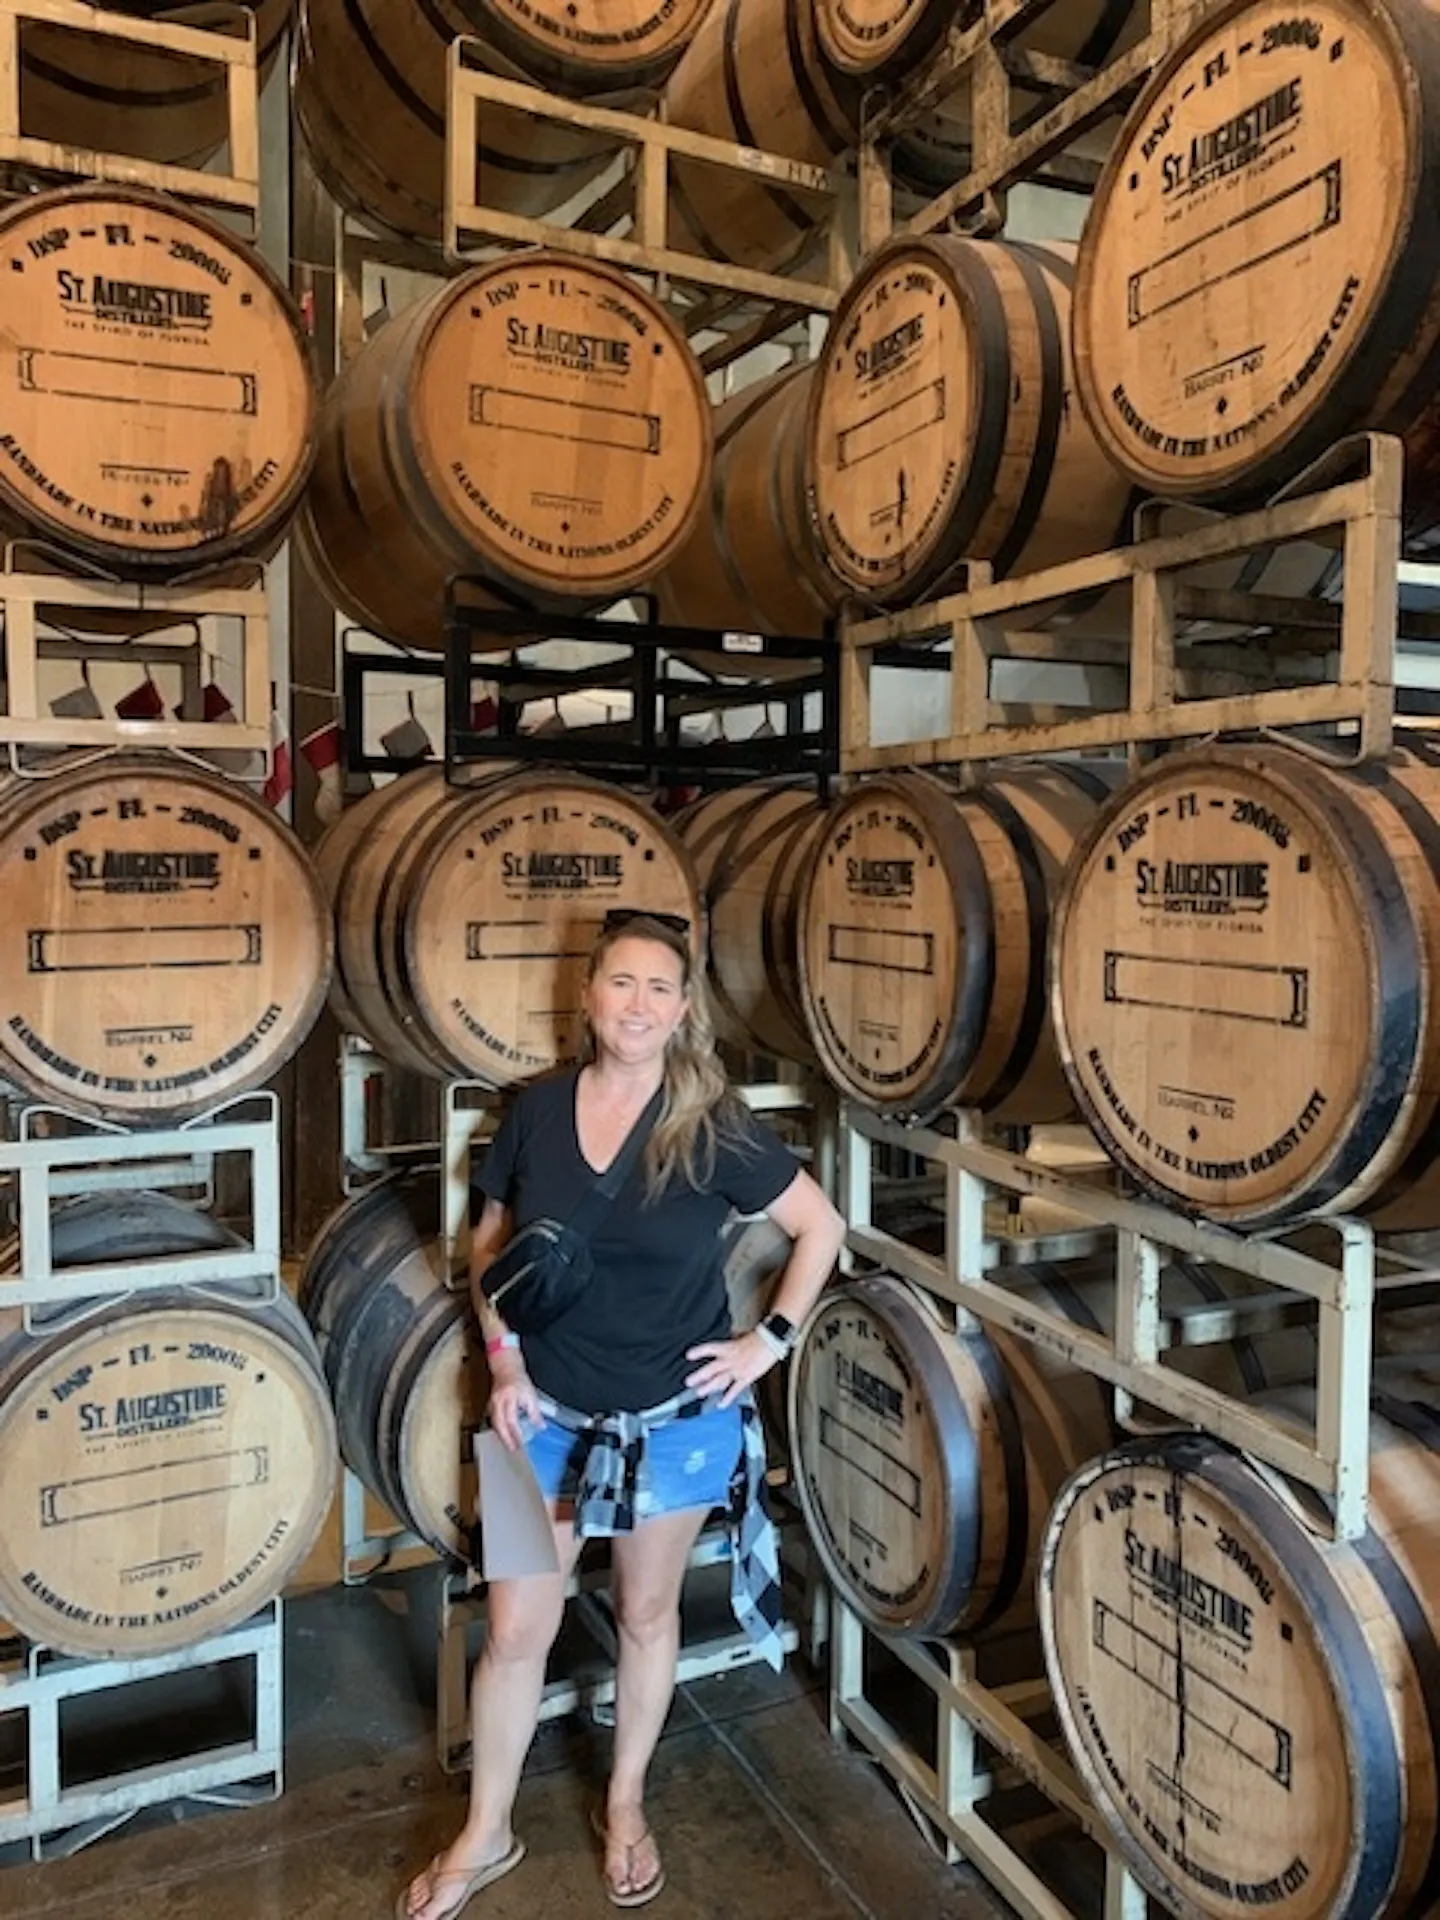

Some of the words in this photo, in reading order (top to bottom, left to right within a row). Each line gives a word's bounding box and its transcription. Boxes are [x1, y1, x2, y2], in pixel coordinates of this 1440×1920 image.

[1188, 75, 1302, 178] AUGUSTINE
[92, 275, 211, 318] AUGUSTINE
[1329, 274, 1360, 331] CITY
[534, 323, 631, 366] AUGUSTINE
[1116, 812, 1150, 852] DSP
[103, 849, 221, 879] AUGUSTINE
[528, 850, 624, 877] AUGUSTINE
[1163, 858, 1269, 898] AUGUSTINE
[1087, 1047, 1138, 1136] HANDMADE
[1136, 1130, 1153, 1151] IN
[1154, 1143, 1181, 1171] THE
[1185, 1157, 1249, 1181] NATIONS
[1250, 1125, 1302, 1174] OLDEST
[1297, 1087, 1328, 1135] CITY
[51, 1364, 93, 1403] DSP
[115, 1383, 228, 1426] AUGUSTINE
[20, 1570, 93, 1624] HANDMADE
[92, 1612, 114, 1628] IN
[118, 1612, 149, 1628] THE
[149, 1592, 220, 1626] NATIONS
[218, 1549, 267, 1597] OLDEST
[264, 1518, 290, 1551] CITY
[1151, 1546, 1255, 1641] AUGUSTINE
